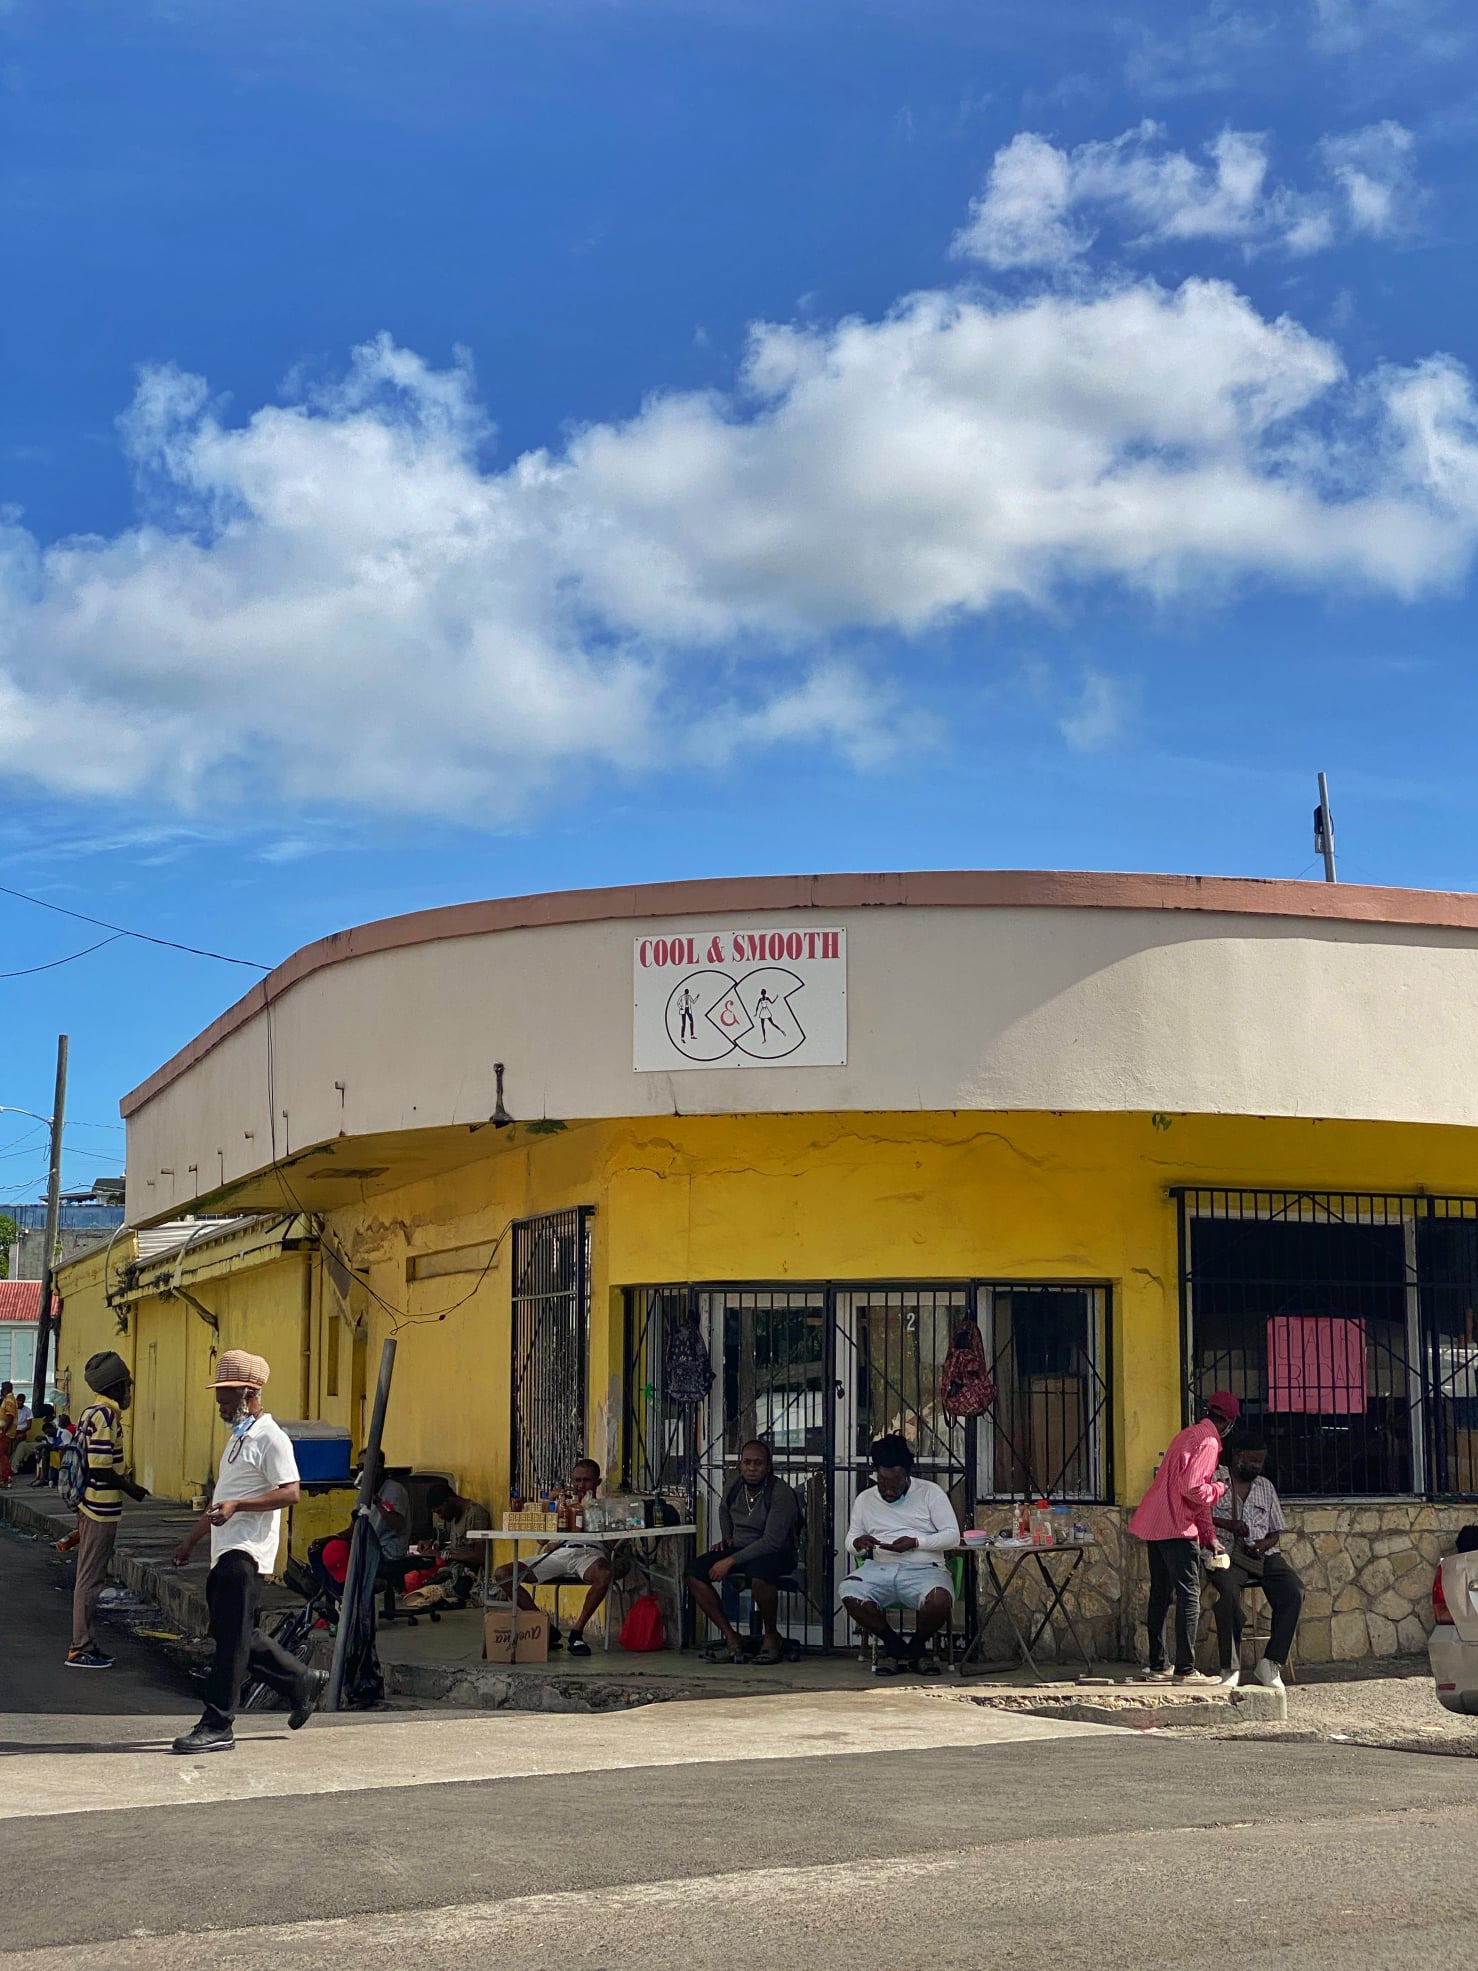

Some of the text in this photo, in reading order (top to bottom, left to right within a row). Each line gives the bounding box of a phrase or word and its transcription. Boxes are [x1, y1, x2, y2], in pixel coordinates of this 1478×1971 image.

[639, 932, 840, 968] COOL & SMOOTH
